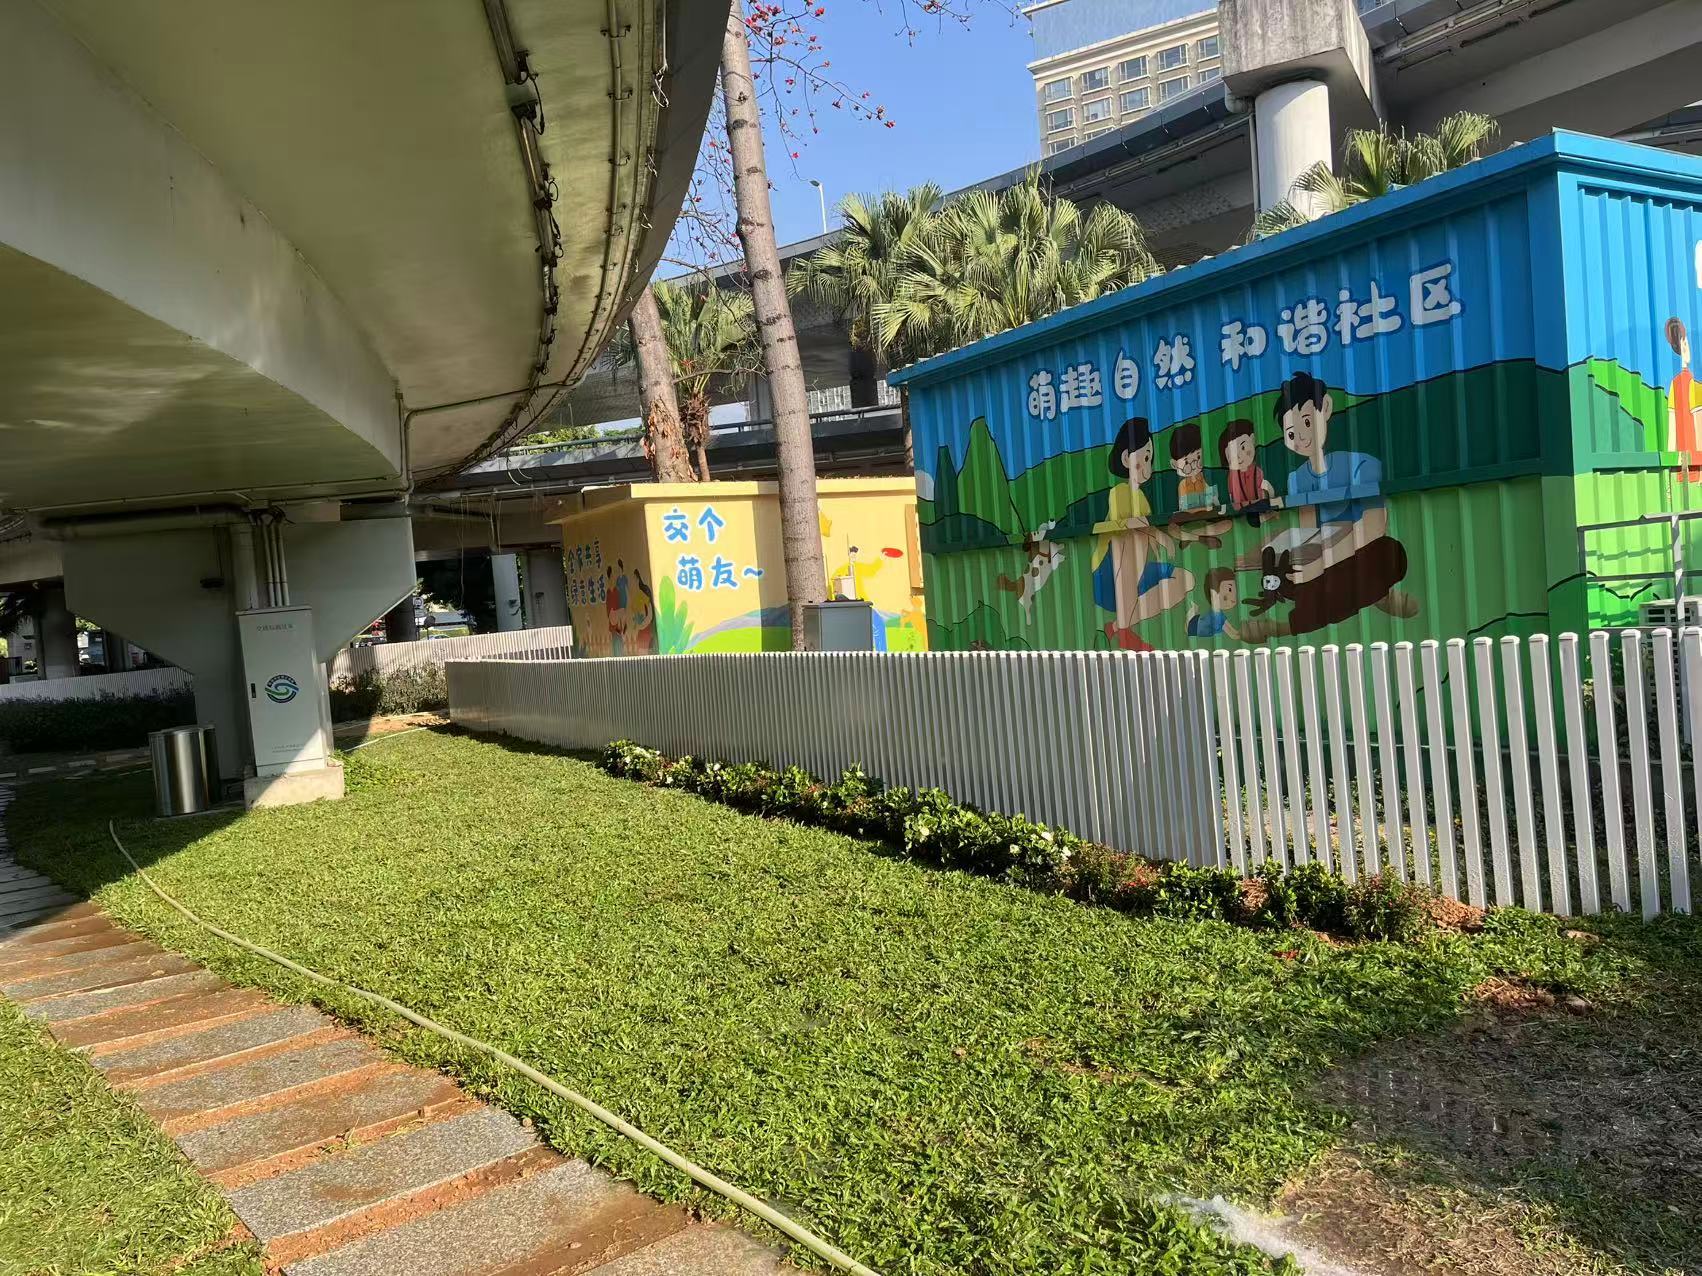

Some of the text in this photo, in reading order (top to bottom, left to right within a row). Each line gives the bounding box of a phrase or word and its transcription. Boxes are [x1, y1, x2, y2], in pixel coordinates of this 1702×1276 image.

[1028, 263, 1462, 420] 萌趣自然 和谐社区
[662, 506, 725, 543] 交个
